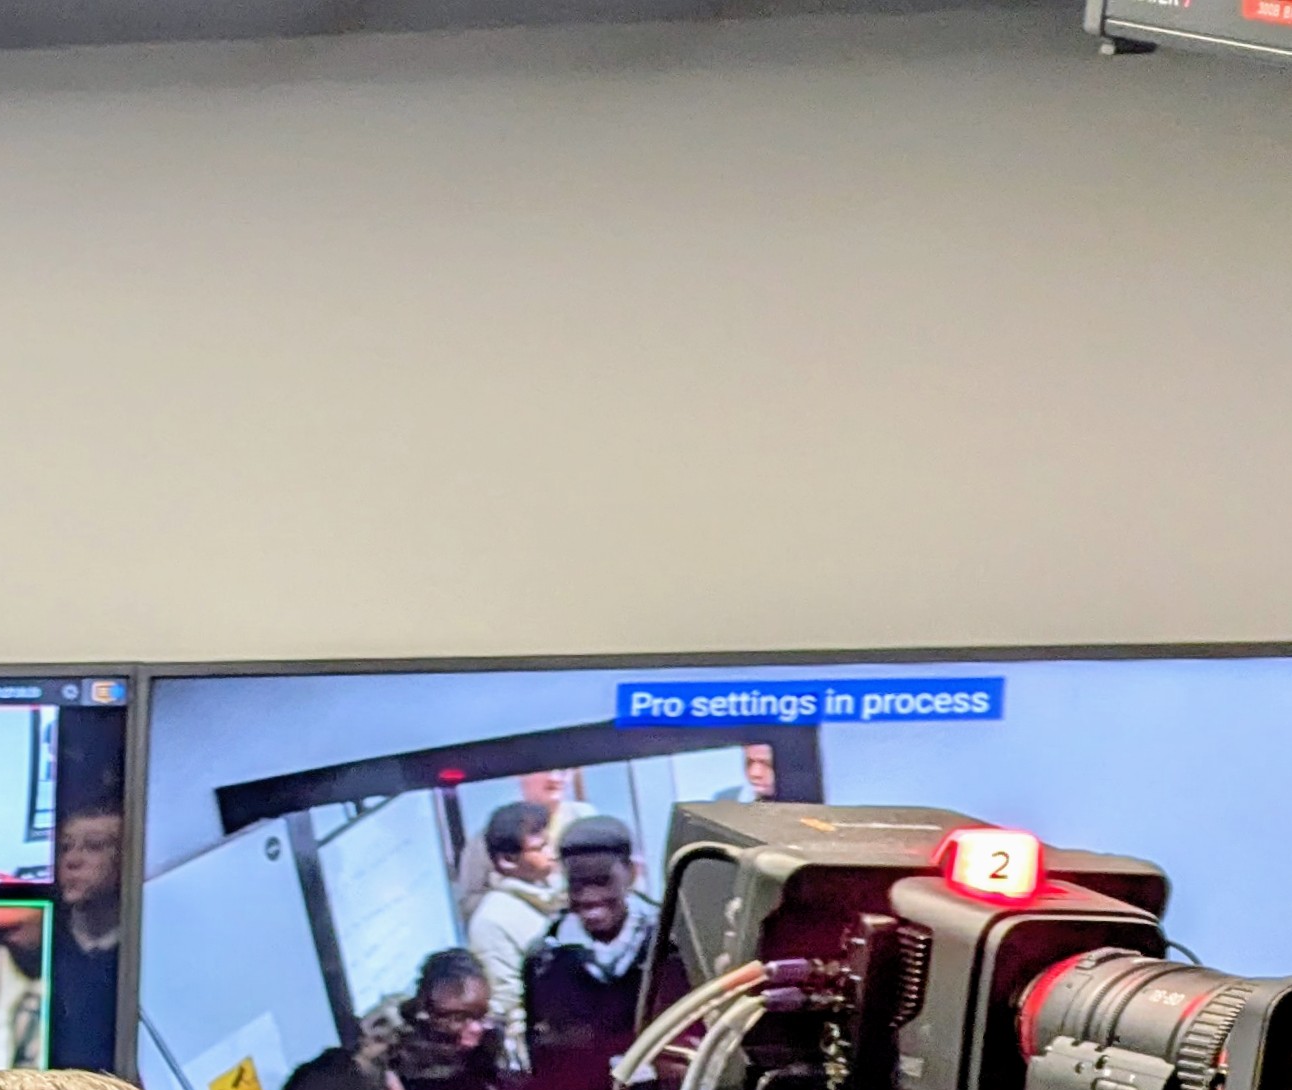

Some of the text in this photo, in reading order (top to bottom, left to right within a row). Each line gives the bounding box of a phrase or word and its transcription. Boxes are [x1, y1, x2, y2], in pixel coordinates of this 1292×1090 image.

[629, 688, 990, 723] Pro settings in process
[989, 851, 1010, 879] 2
